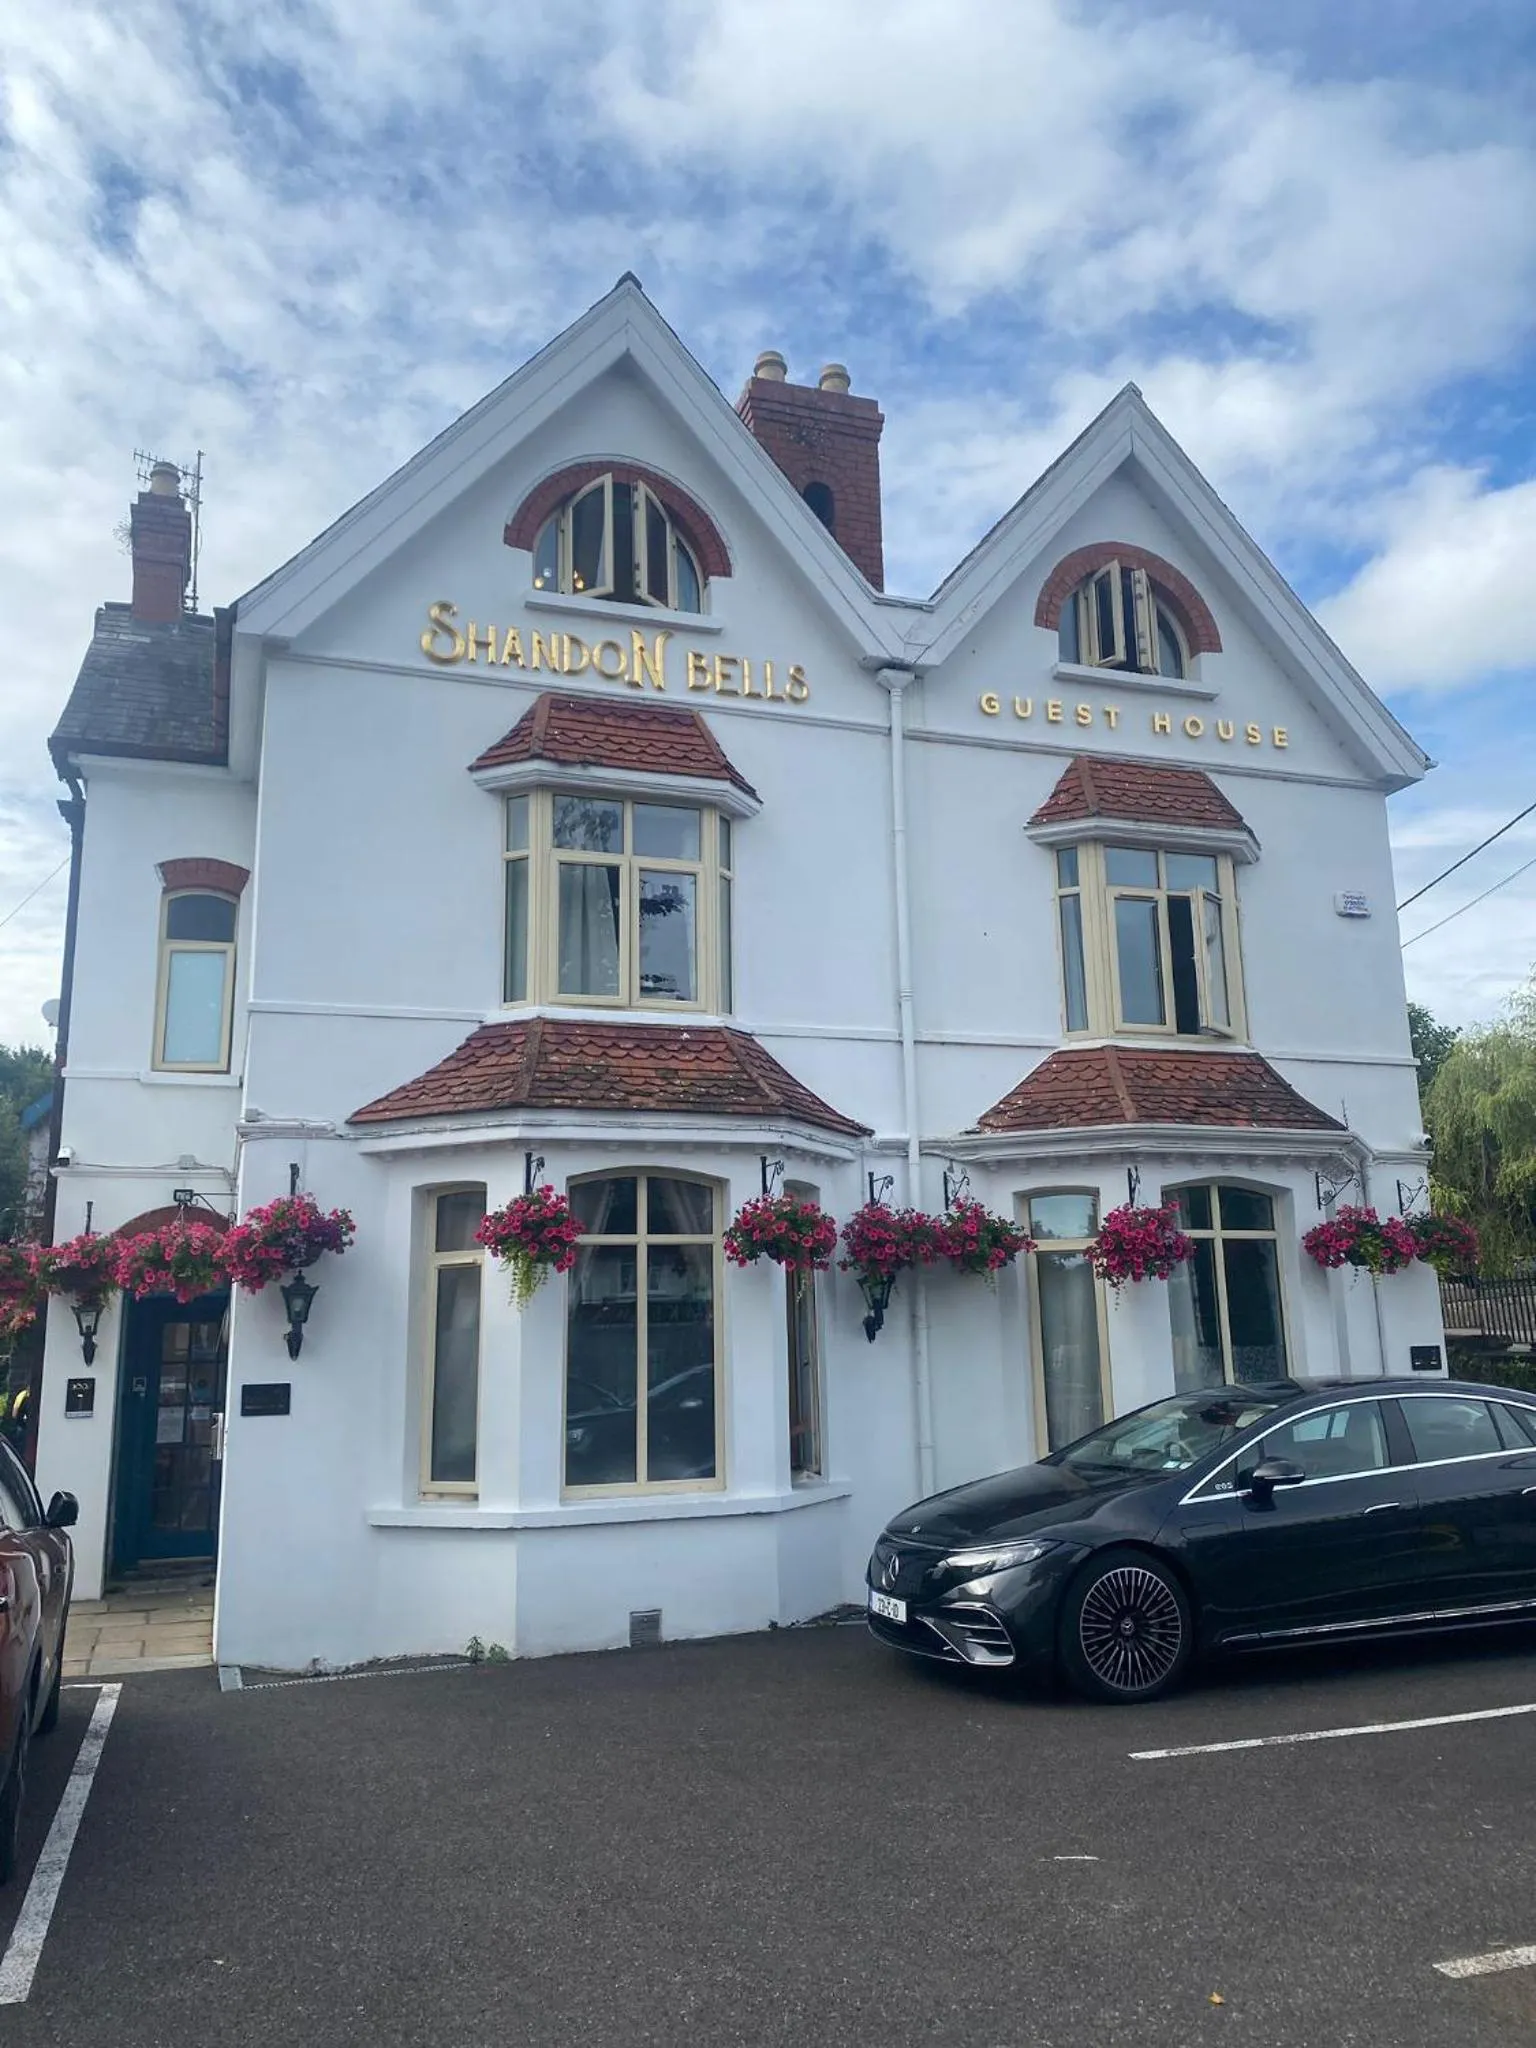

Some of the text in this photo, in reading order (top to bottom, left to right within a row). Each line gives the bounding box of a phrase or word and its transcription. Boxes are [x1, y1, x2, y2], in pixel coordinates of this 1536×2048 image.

[420, 600, 811, 703] SHANDON BELLS
[979, 691, 1289, 749] GUEST HOUSE
